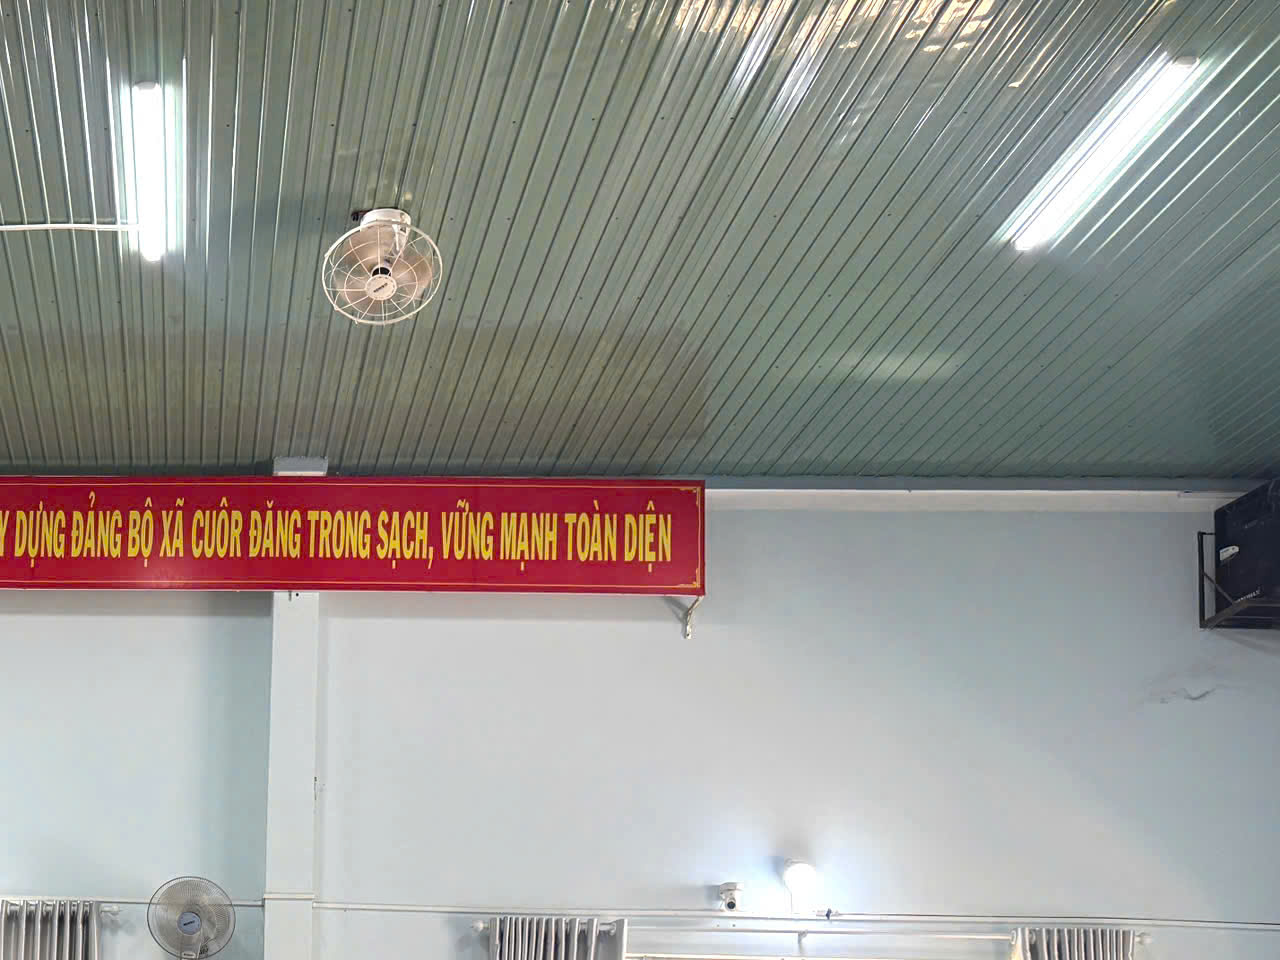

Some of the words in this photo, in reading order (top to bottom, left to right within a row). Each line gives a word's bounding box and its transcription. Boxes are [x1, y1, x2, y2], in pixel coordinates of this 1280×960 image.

[14, 501, 65, 567] DỰNG
[71, 491, 122, 558] ĐẢNG
[127, 497, 154, 567] BỘ
[160, 498, 184, 557] XÃ
[191, 497, 243, 558] CUÔR
[249, 500, 301, 559] ĐĂNG
[307, 510, 371, 560] TRONG
[376, 511, 433, 569] SẠCH,
[441, 500, 493, 561] VỮNG
[500, 512, 557, 571] MẠNH
[564, 502, 617, 561] TOÀN
[624, 502, 671, 572] DIỆN
